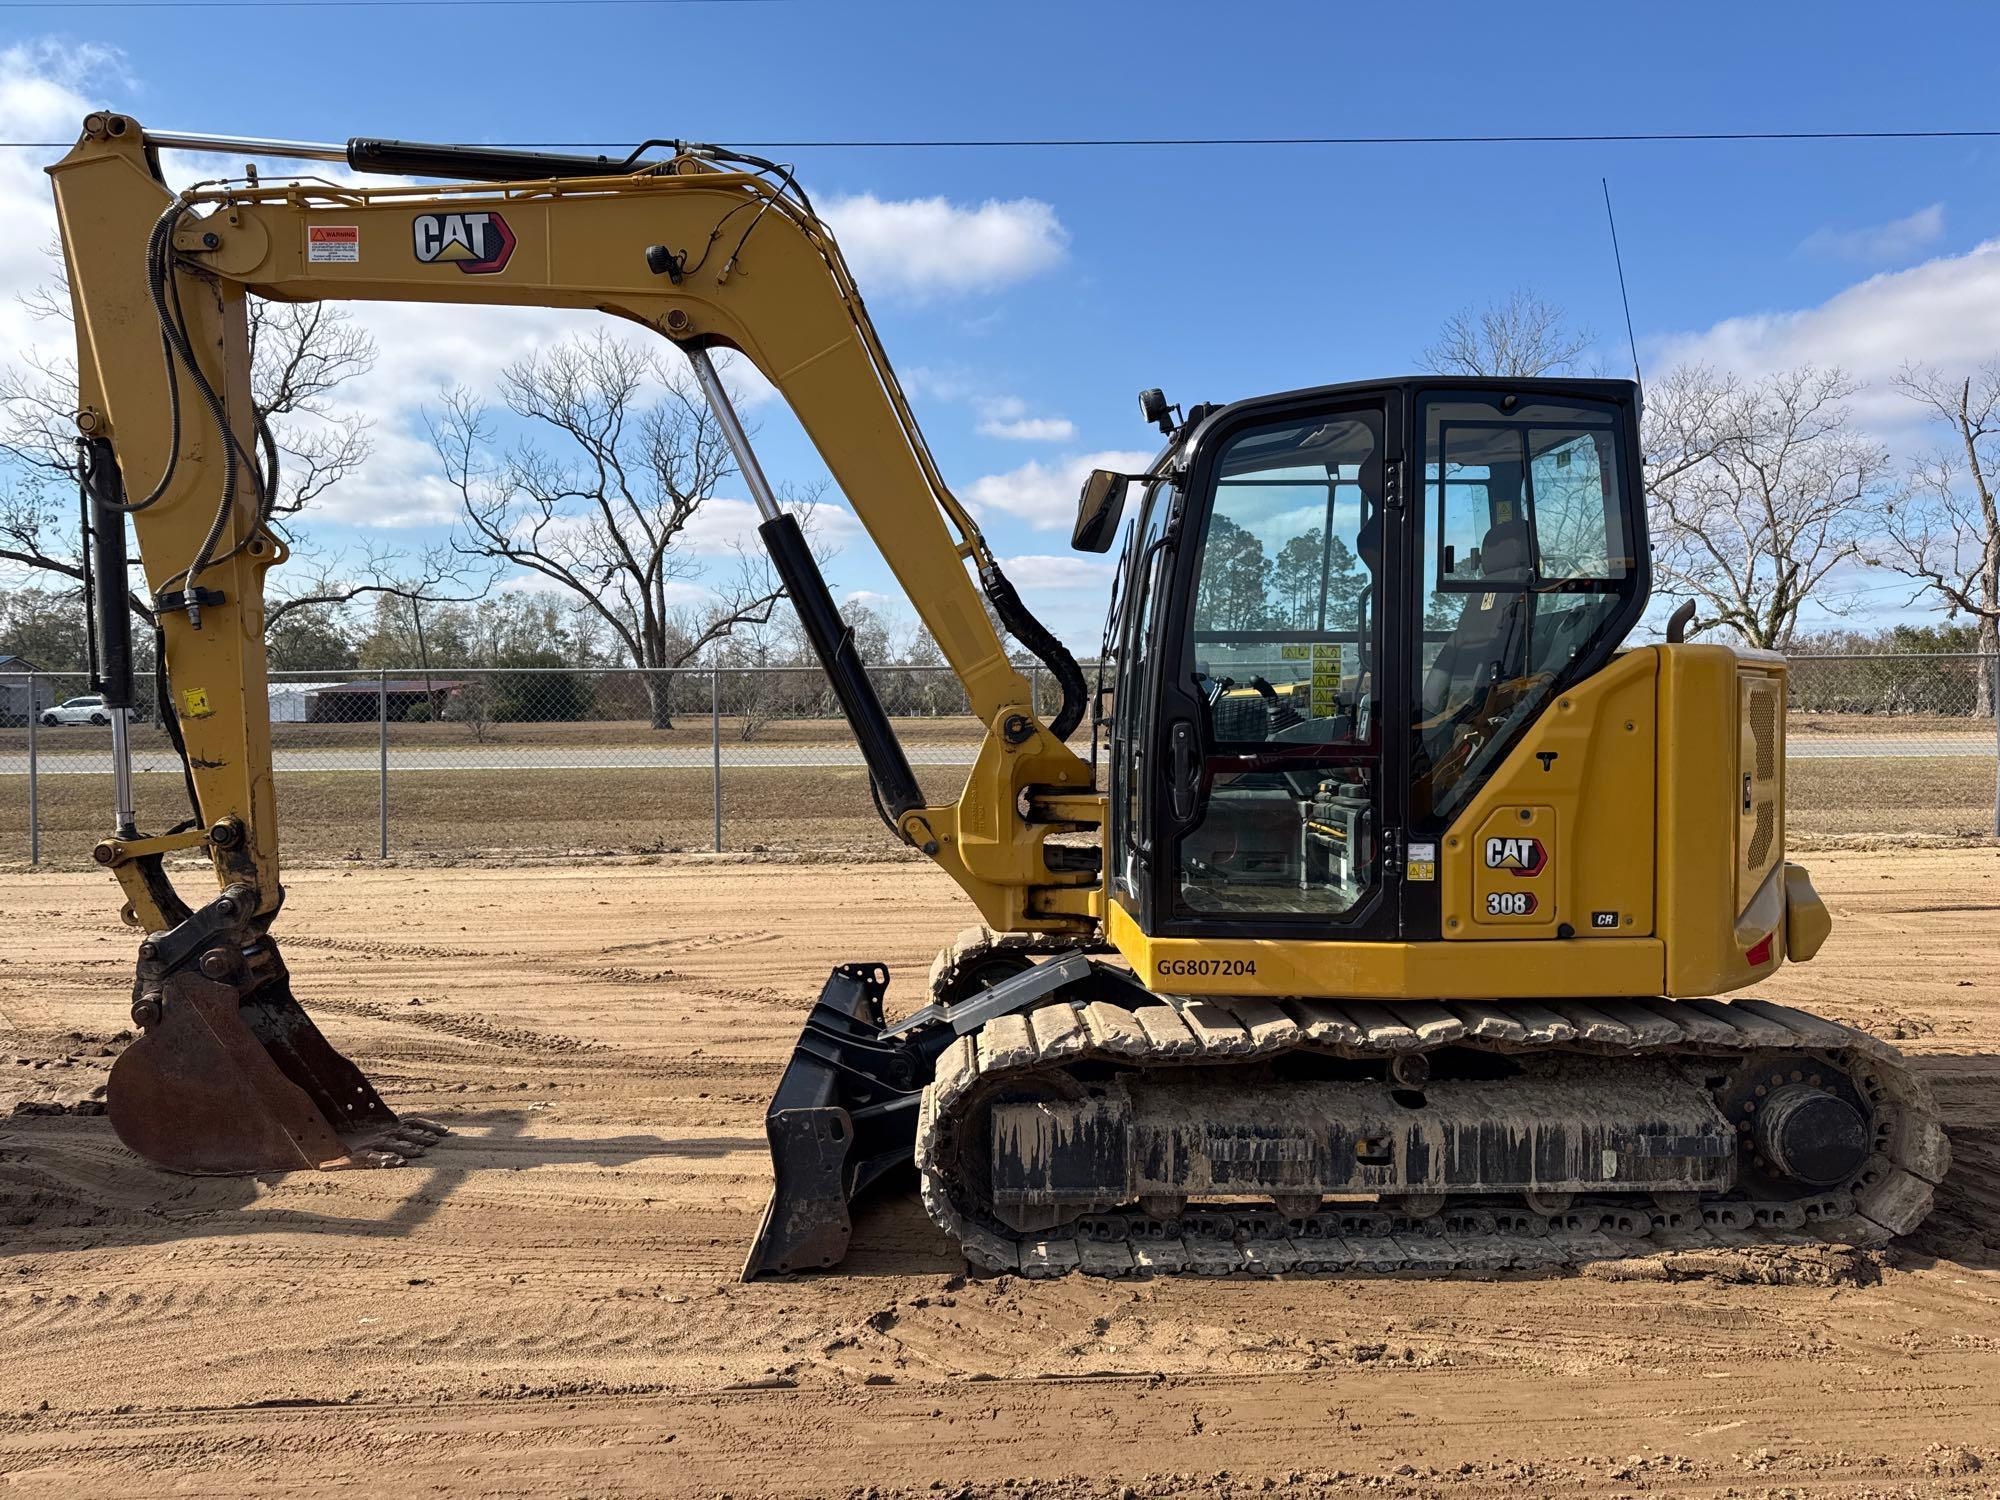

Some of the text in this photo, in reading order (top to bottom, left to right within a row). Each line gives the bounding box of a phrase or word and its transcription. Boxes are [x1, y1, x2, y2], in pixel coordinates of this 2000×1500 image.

[414, 213, 489, 262] CAT
[1486, 838, 1533, 868] CAT
[1487, 893, 1526, 914] 308
[1597, 914, 1613, 925] CR
[1157, 959, 1256, 976] GG807204
